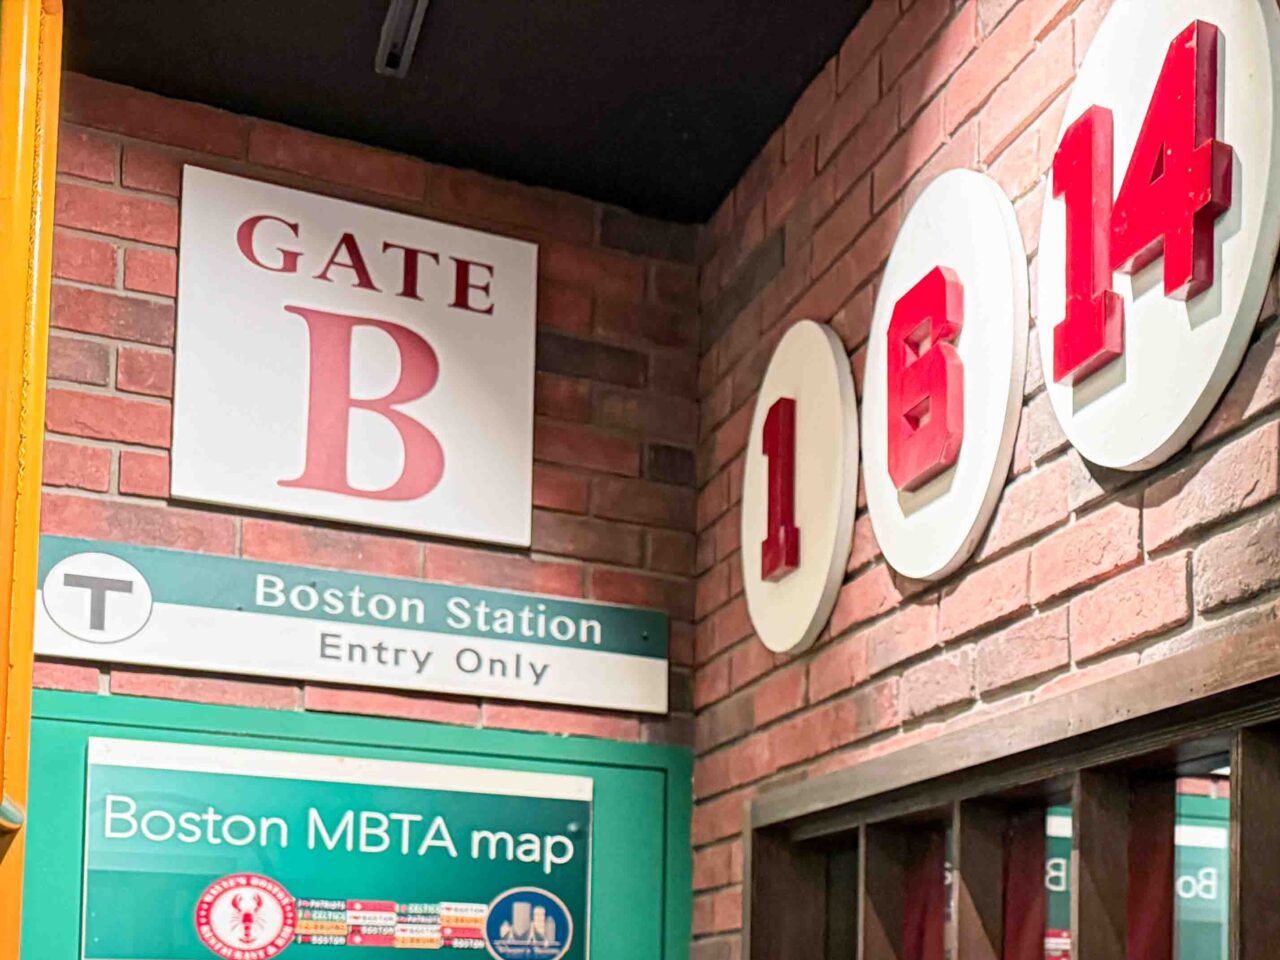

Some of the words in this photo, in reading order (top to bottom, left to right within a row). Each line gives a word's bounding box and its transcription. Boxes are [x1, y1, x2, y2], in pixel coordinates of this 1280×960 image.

[1052, 18, 1232, 388] 14
[236, 214, 496, 316] GATE
[277, 304, 446, 502] B
[887, 264, 966, 492] 6
[762, 397, 799, 583] 1
[62, 572, 134, 631] T
[255, 573, 426, 624] Boston
[447, 595, 602, 645] Station
[319, 632, 433, 674] Entry
[455, 647, 550, 686] Only
[104, 795, 289, 848] Boston
[307, 807, 458, 859] MBTA
[470, 829, 574, 875] map
